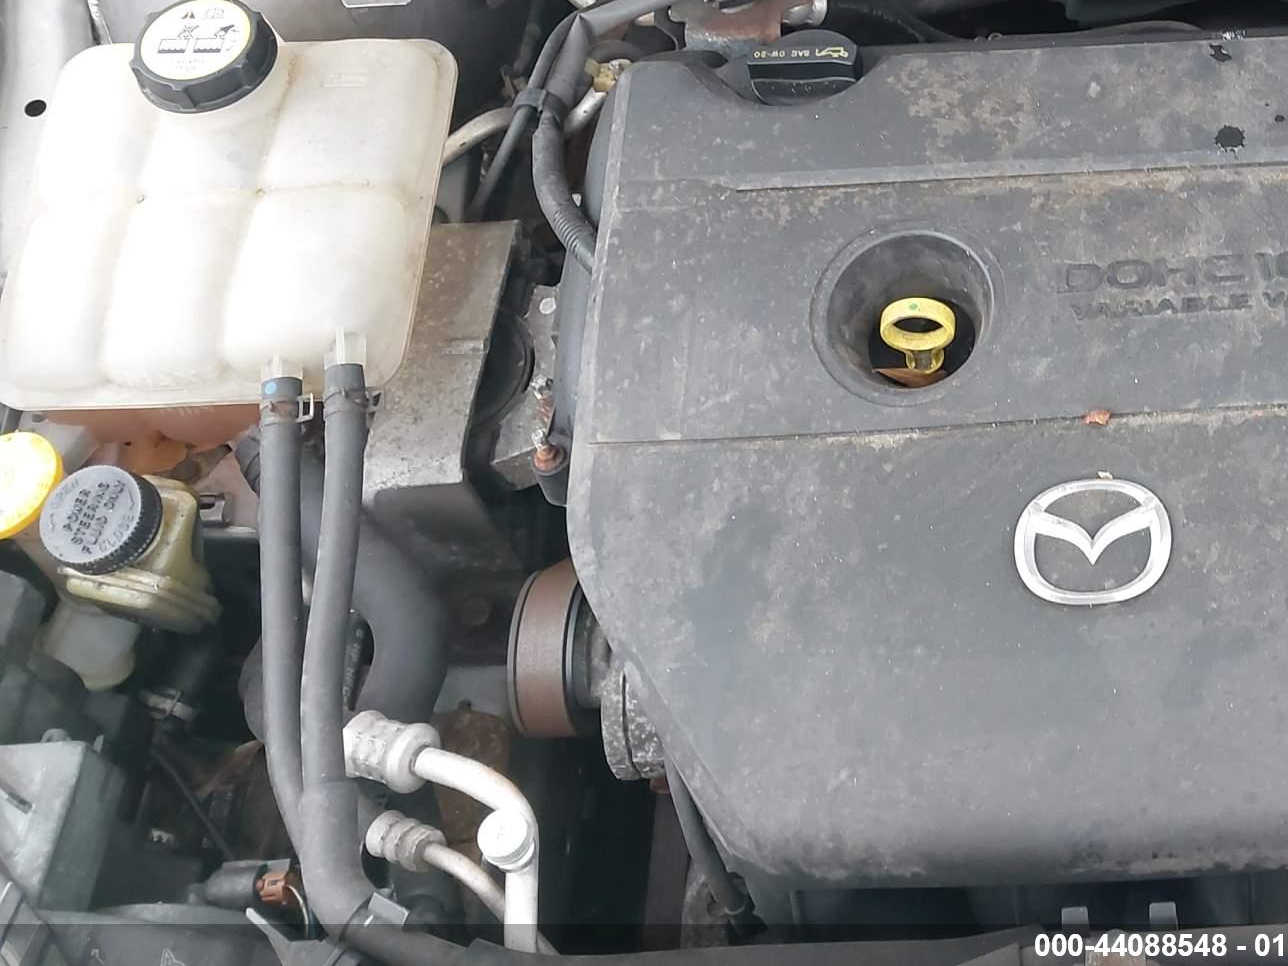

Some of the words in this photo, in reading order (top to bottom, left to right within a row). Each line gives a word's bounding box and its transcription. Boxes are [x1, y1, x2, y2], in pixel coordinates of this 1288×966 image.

[1059, 253, 1247, 293] DOHC
[1070, 294, 1252, 321] VARIABLE
[62, 488, 92, 533] POWER
[70, 482, 110, 546] STEERING
[81, 515, 108, 555] FLUID
